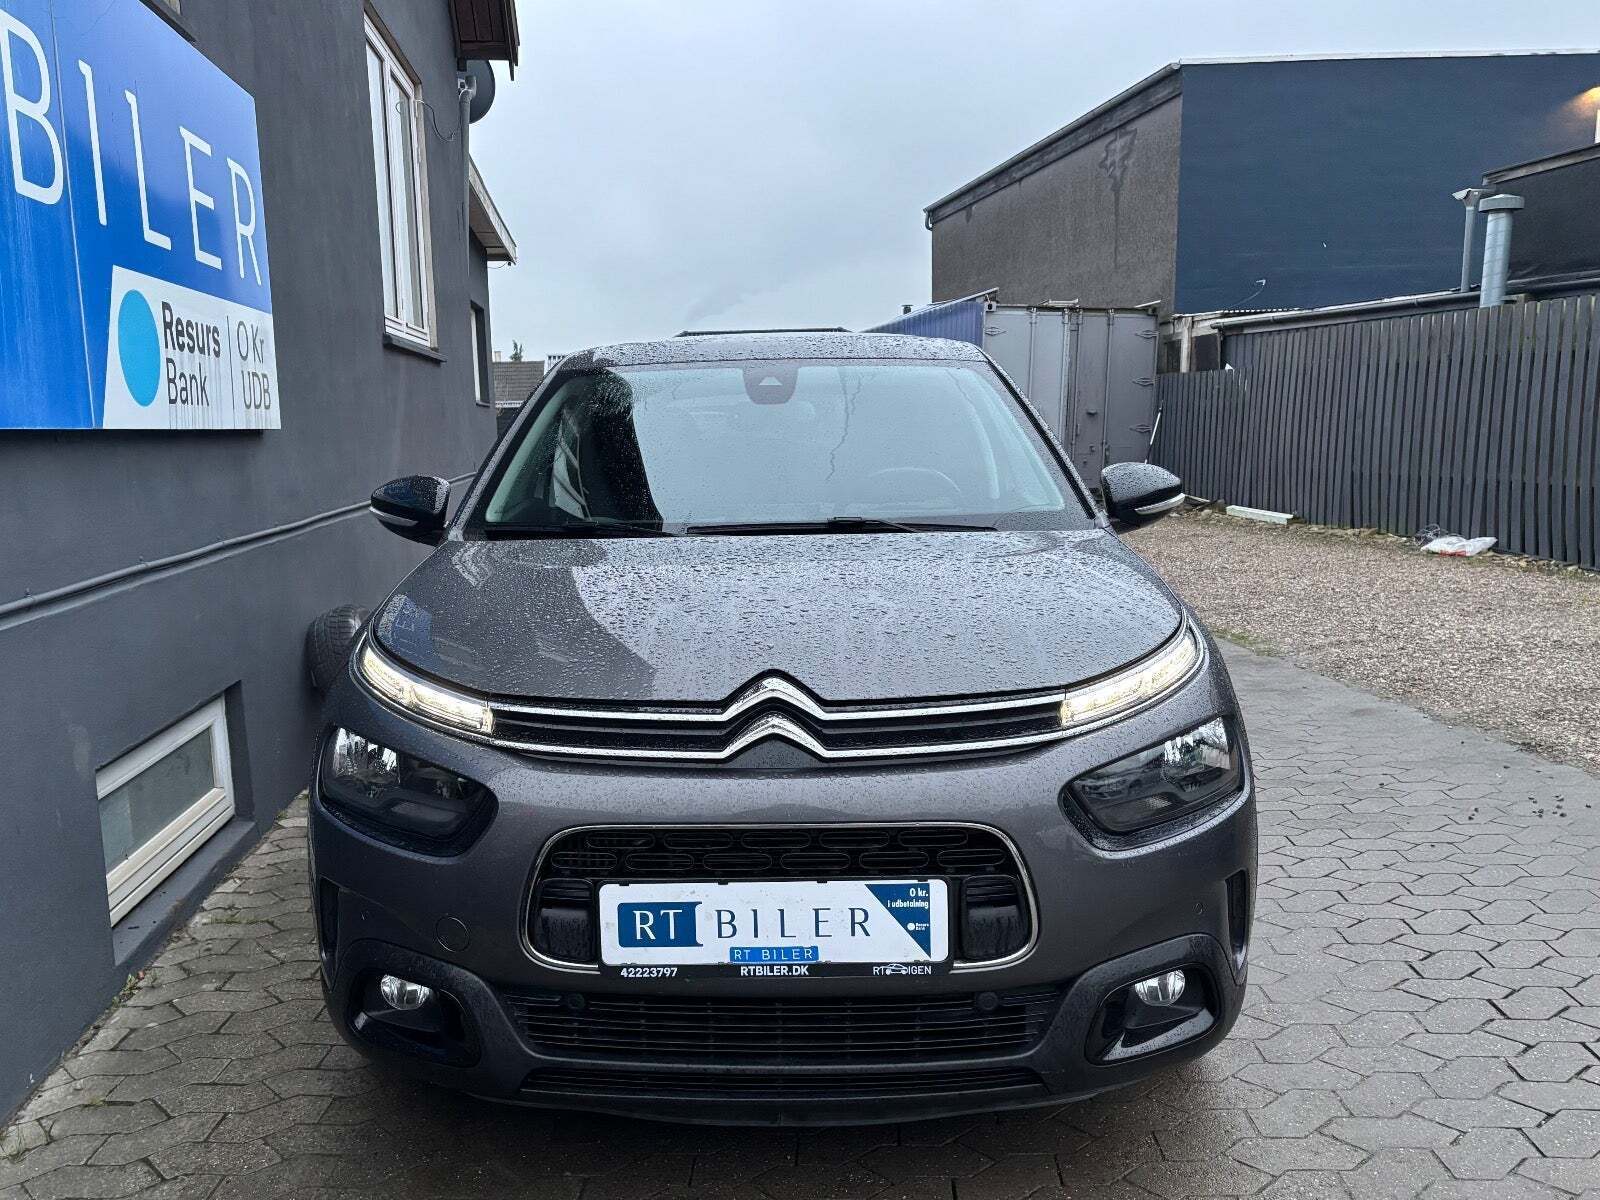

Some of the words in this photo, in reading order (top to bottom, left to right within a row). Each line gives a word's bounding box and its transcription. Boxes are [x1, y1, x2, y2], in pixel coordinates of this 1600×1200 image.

[0, 8, 262, 286] BILER
[161, 301, 221, 359] Resurs
[251, 323, 265, 364] Kr
[165, 357, 210, 407] Bank
[241, 369, 271, 410] UDB
[909, 887, 917, 897] 0
[917, 887, 929, 897] kr.
[633, 909, 683, 940] RT
[715, 907, 871, 939] BILER
[620, 967, 678, 978] 42223797
[734, 949, 751, 960] RT
[761, 948, 813, 960] BILER
[740, 965, 809, 976] RTBILER.DK
